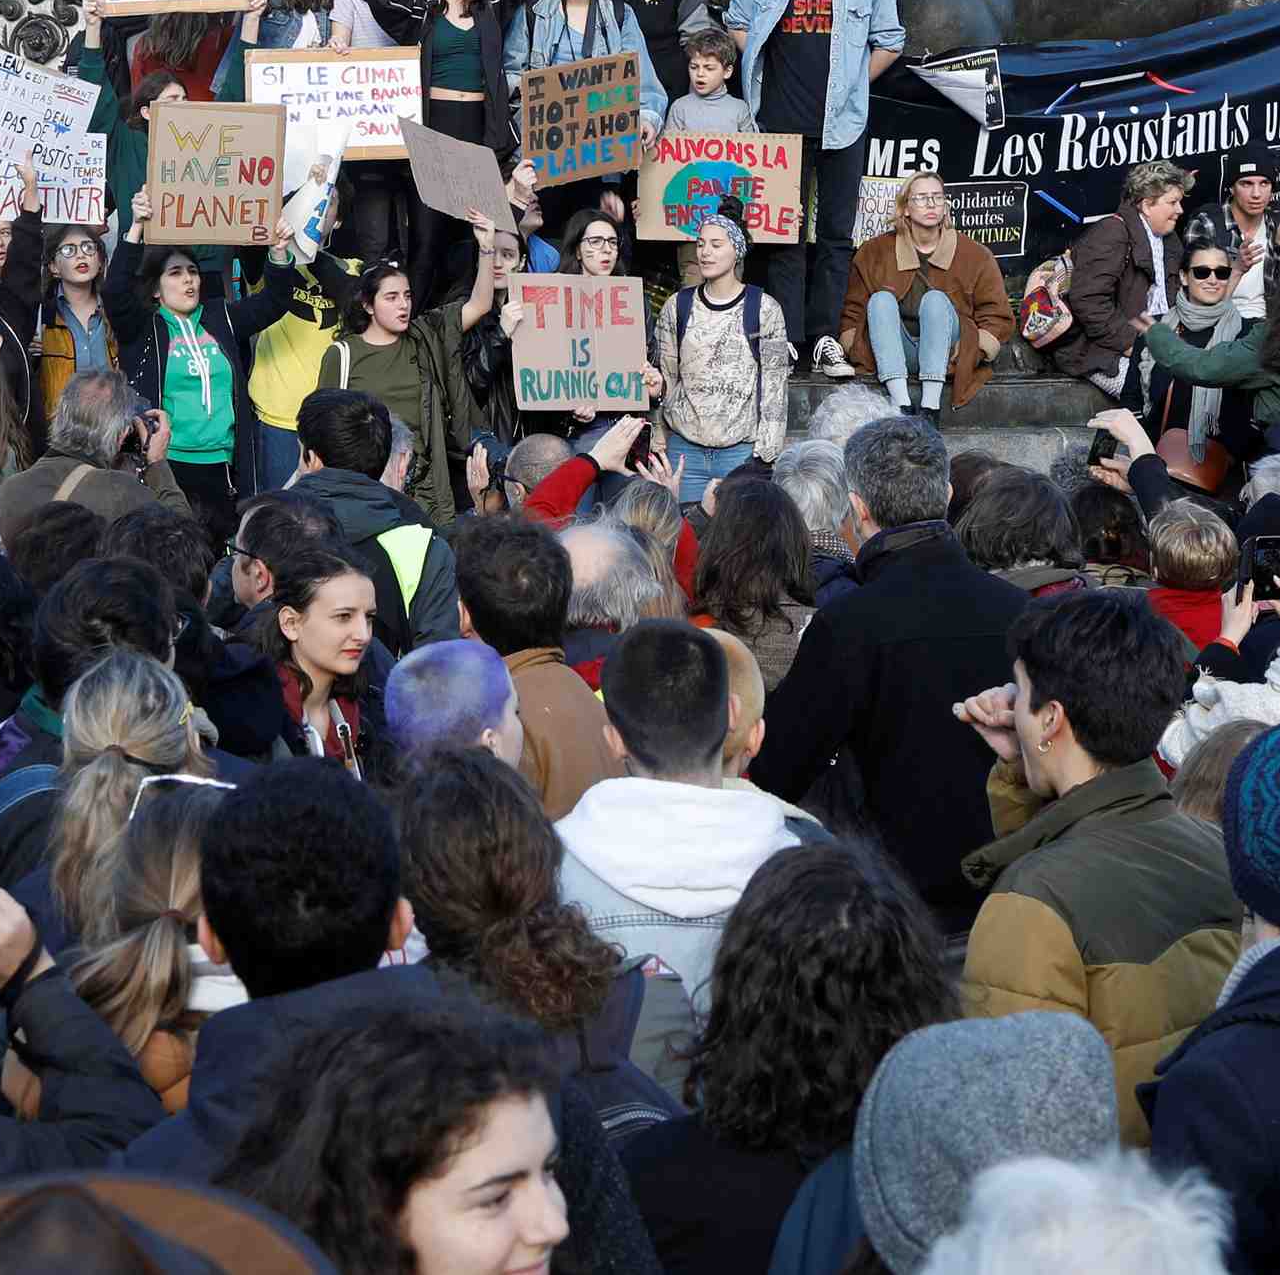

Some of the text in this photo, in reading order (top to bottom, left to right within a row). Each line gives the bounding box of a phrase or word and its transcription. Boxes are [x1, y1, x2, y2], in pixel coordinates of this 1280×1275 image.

[262, 66, 407, 86] SI LE CLIMAT
[528, 60, 636, 102] I WANT A
[1, 110, 27, 134] PAS
[30, 122, 50, 143] DE
[529, 96, 580, 127] HOT
[167, 120, 244, 157] WE
[529, 109, 641, 151] NOT A HOT
[969, 124, 1045, 177] Les
[1055, 92, 1251, 172] Résistants
[32, 143, 72, 170] PASTIS
[161, 156, 275, 187] HAVE NO
[531, 133, 639, 178] PLANET
[762, 143, 789, 170] LA
[72, 166, 104, 178] TEMPS
[160, 192, 269, 228] PLANET
[961, 209, 1005, 226] toutes
[251, 226, 269, 242] B
[522, 285, 635, 330] TIME
[571, 338, 591, 368] IS
[519, 368, 646, 402] RUNNIG OUT
